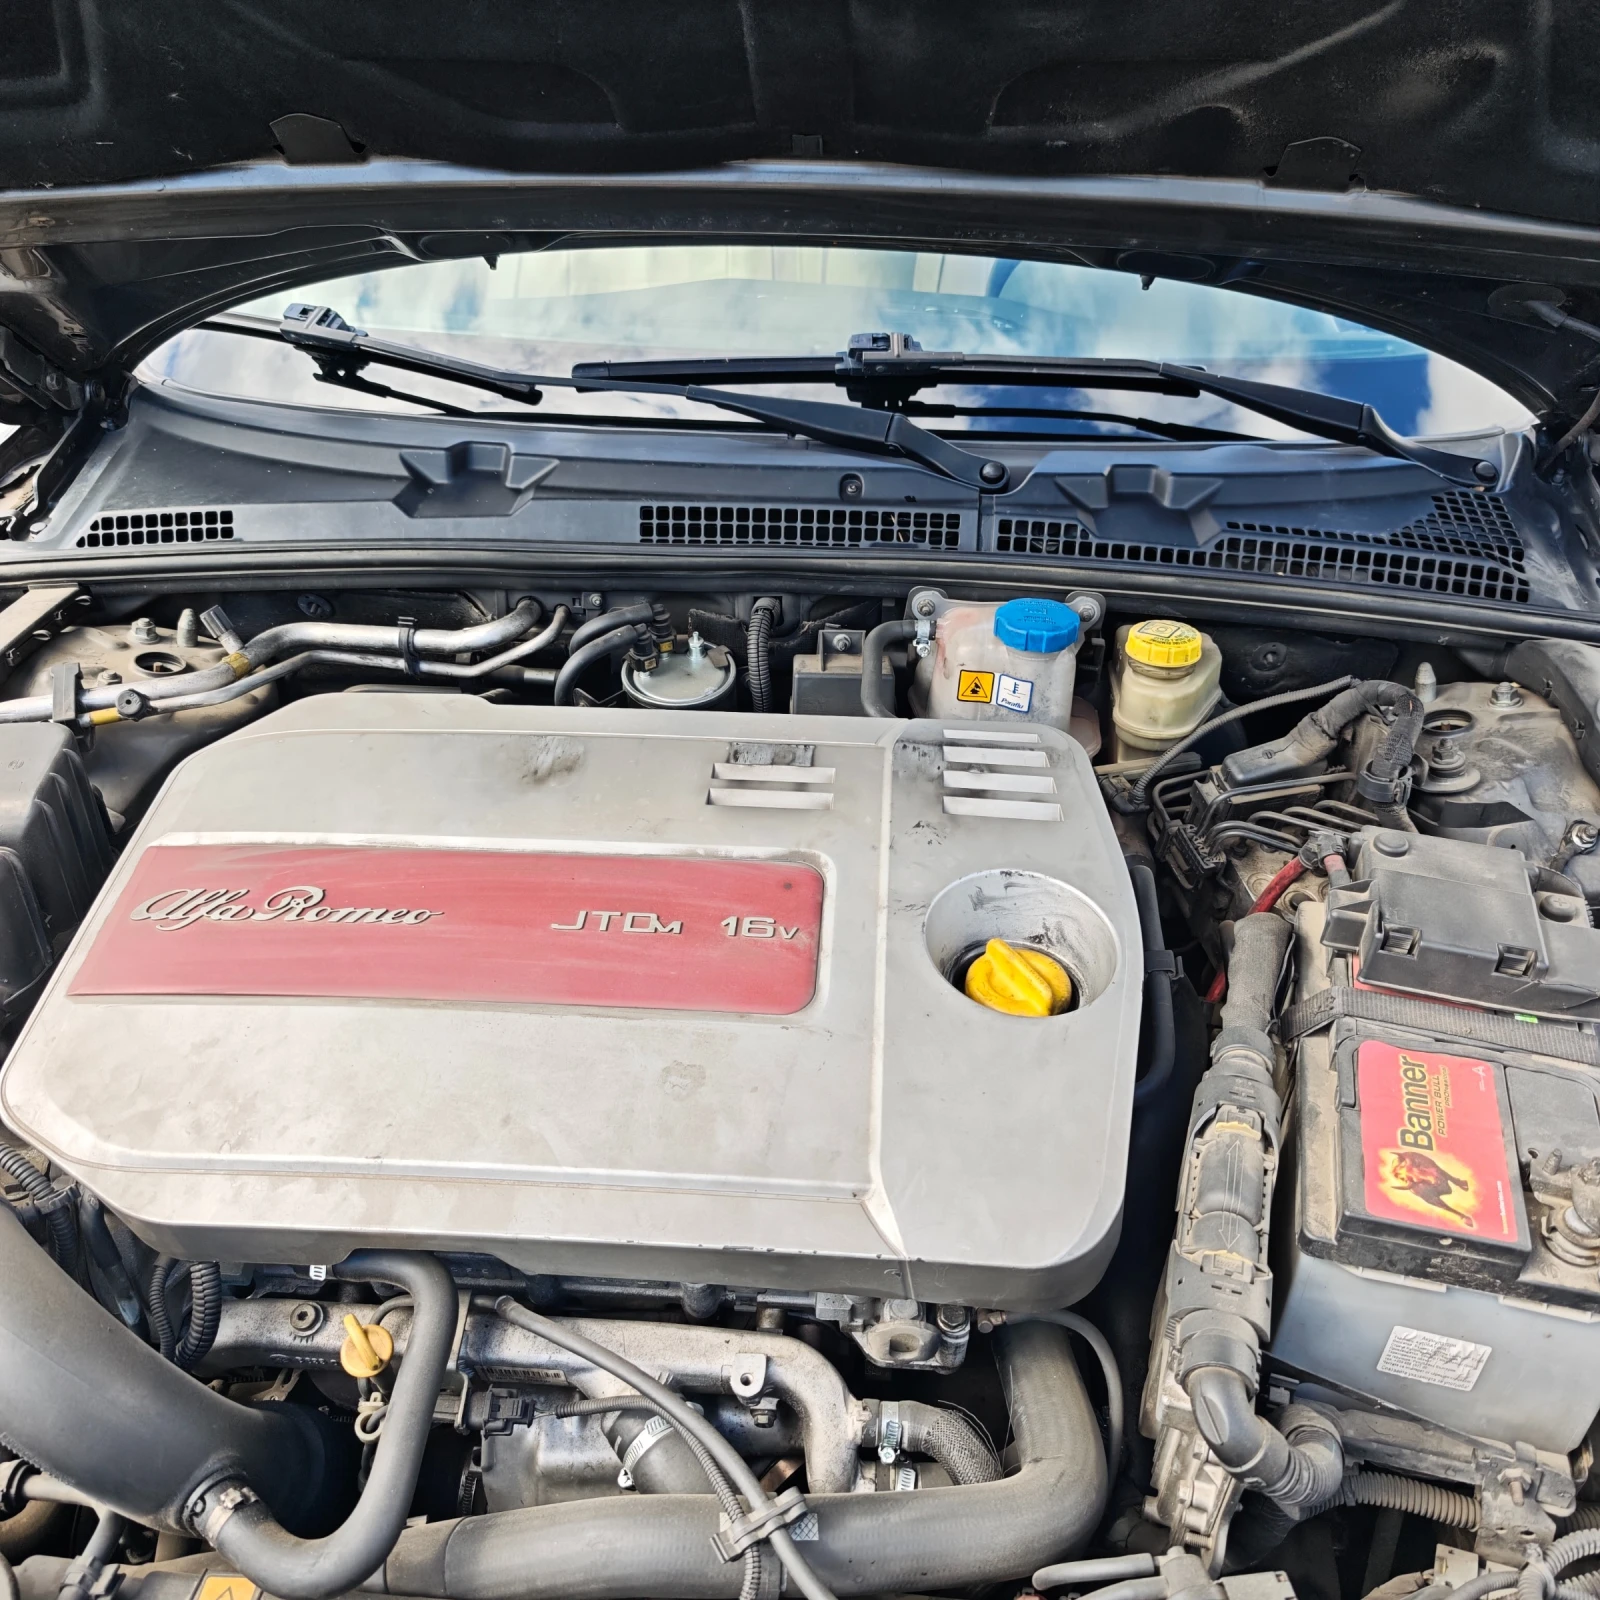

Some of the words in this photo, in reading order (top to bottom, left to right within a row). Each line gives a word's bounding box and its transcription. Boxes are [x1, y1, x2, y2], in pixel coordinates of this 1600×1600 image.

[130, 888, 254, 931] Alfa
[252, 885, 444, 925] Romeo
[1399, 1055, 1434, 1152] Banner
[1433, 1075, 1442, 1099] BULL
[1435, 1101, 1446, 1136] POWER
